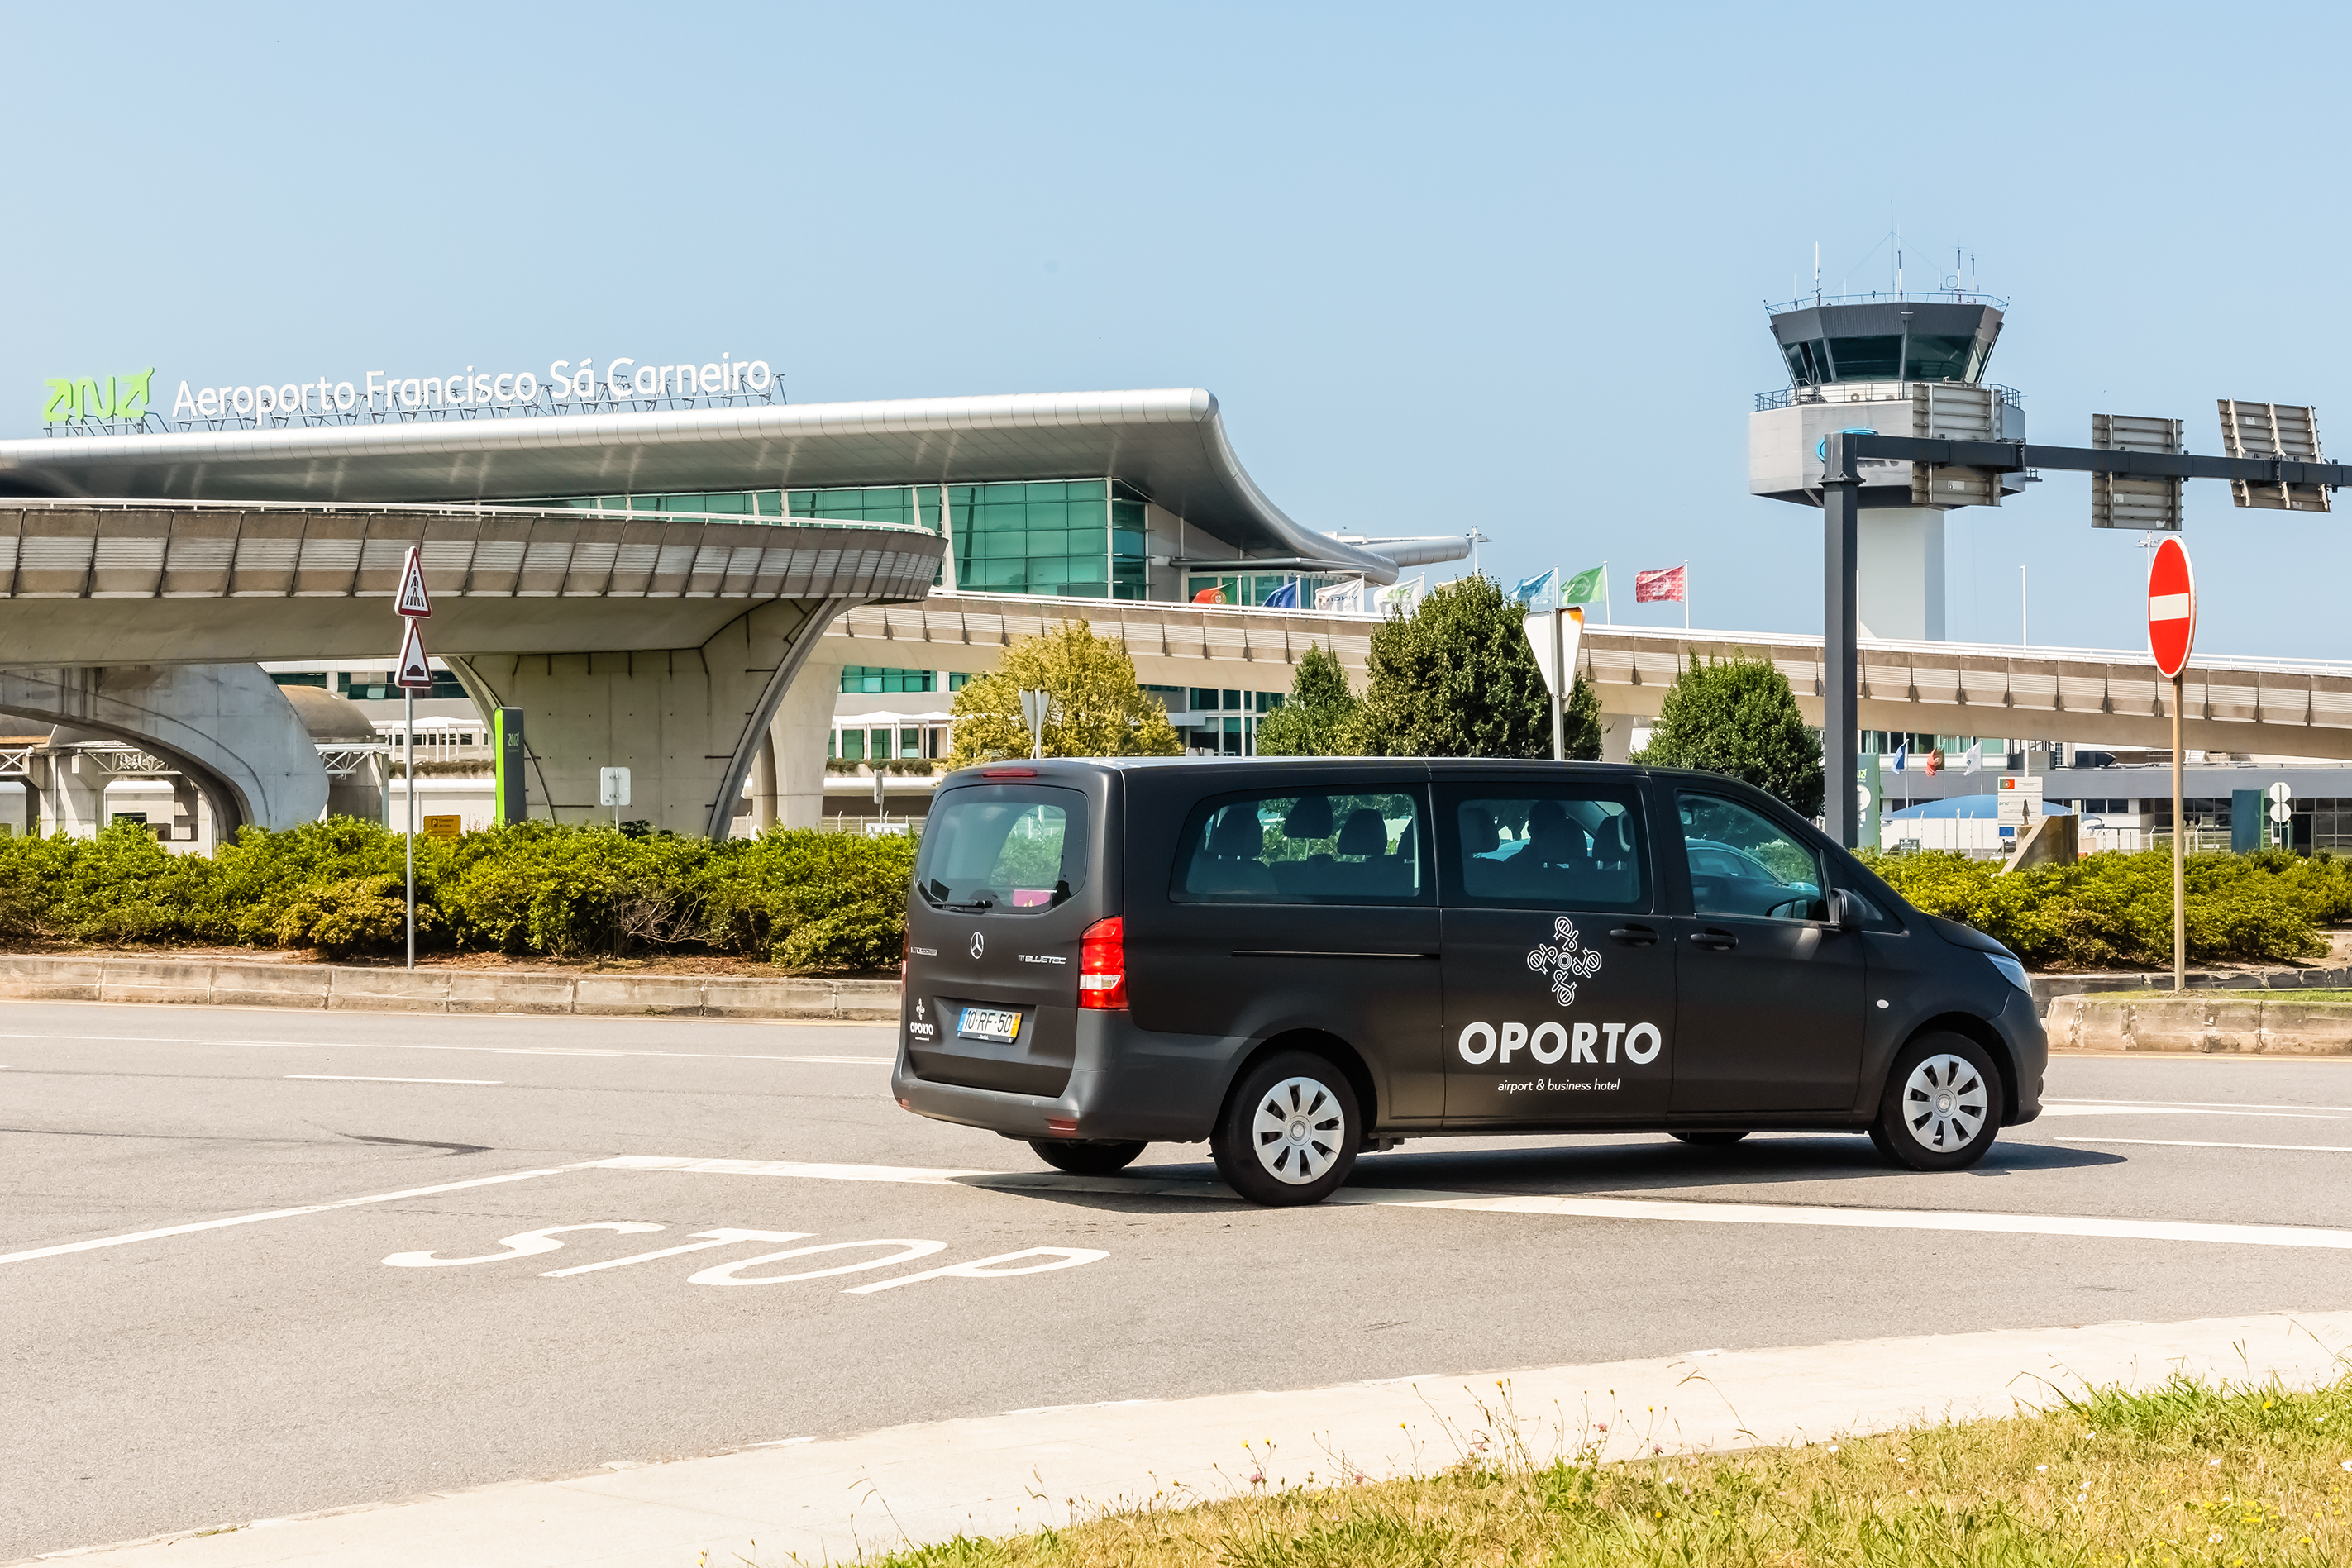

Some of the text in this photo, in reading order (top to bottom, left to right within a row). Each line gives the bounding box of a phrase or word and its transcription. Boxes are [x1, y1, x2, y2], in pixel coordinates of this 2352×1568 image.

[172, 353, 771, 426] Aeroporto Francisco Sá Carneiro
[1025, 955, 1066, 965] BLUETEC
[909, 1022, 934, 1036] OPORTO
[1458, 1022, 1662, 1065] OPORTO
[1497, 1078, 1620, 1094] airport & business hotel
[380, 1221, 1111, 1295] STOP
